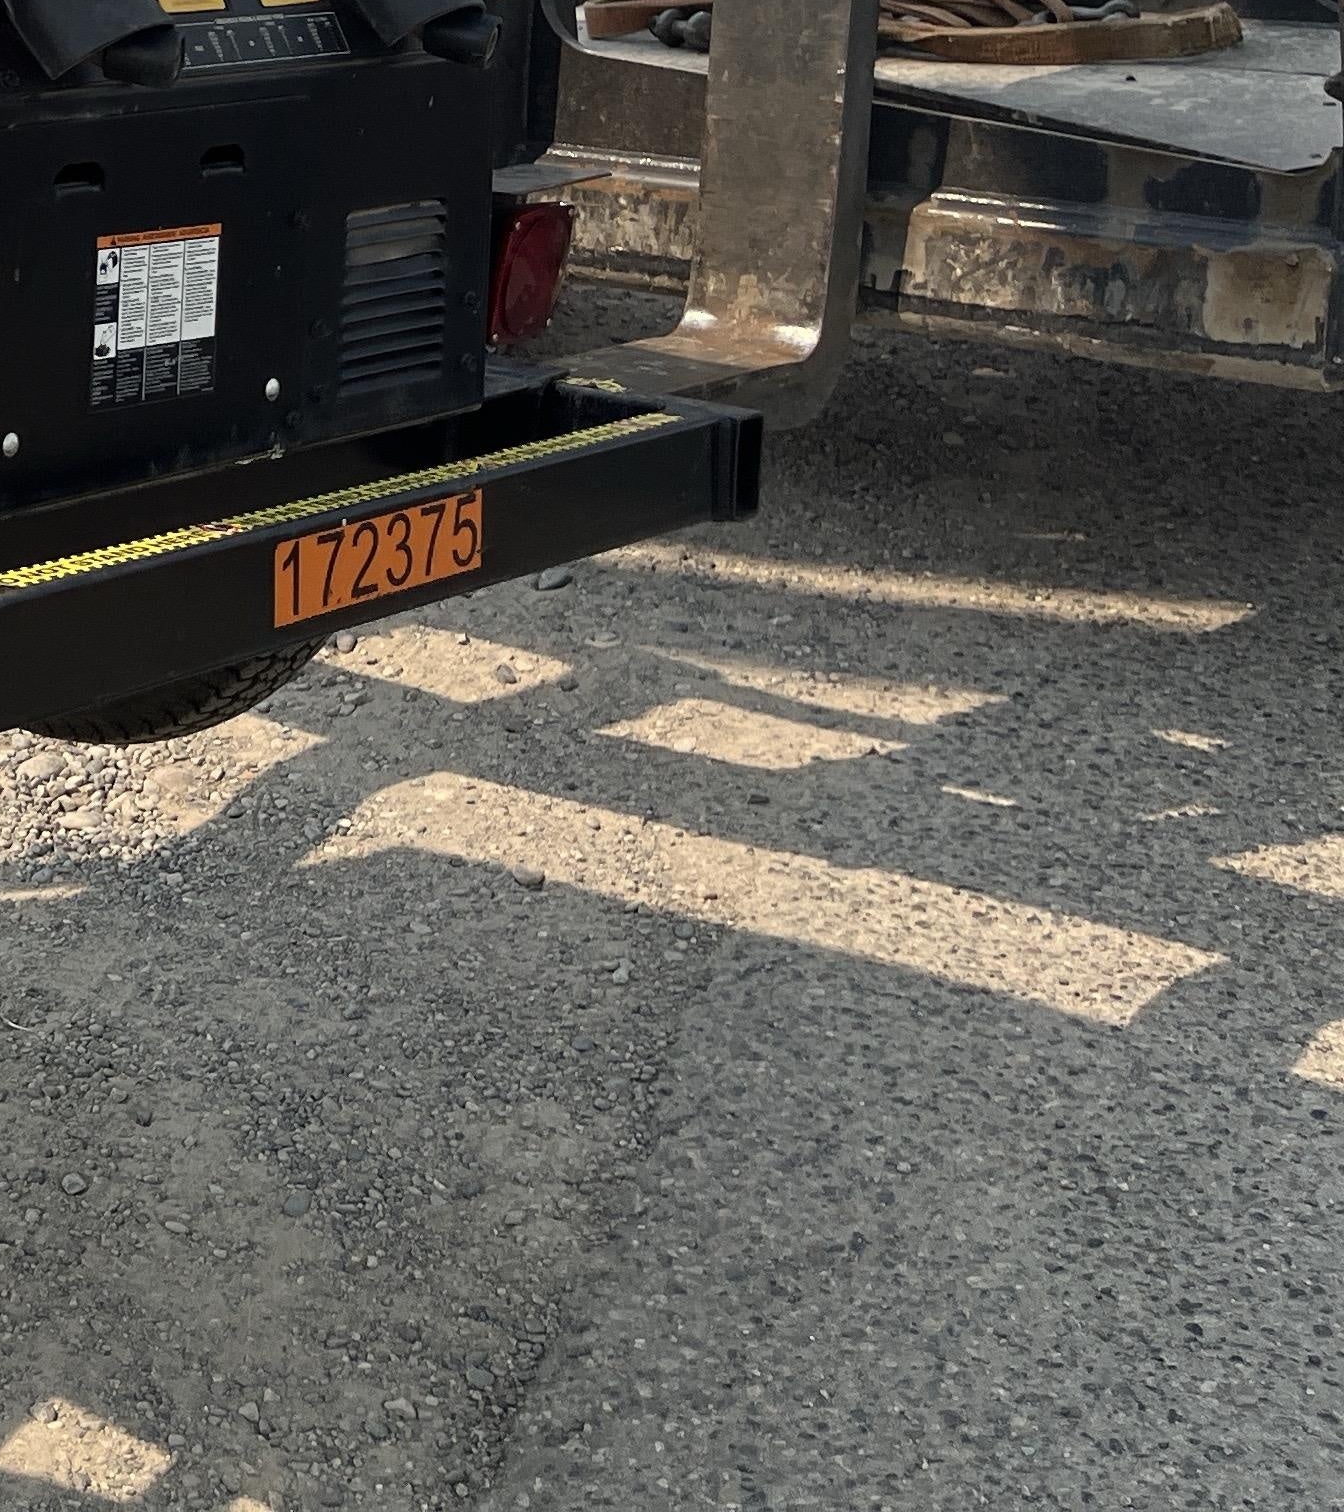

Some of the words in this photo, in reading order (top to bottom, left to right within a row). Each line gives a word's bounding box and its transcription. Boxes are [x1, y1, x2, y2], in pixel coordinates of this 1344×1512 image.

[21, 563, 72, 580] NOT
[71, 543, 148, 568] STAND
[281, 491, 479, 618] 172375
